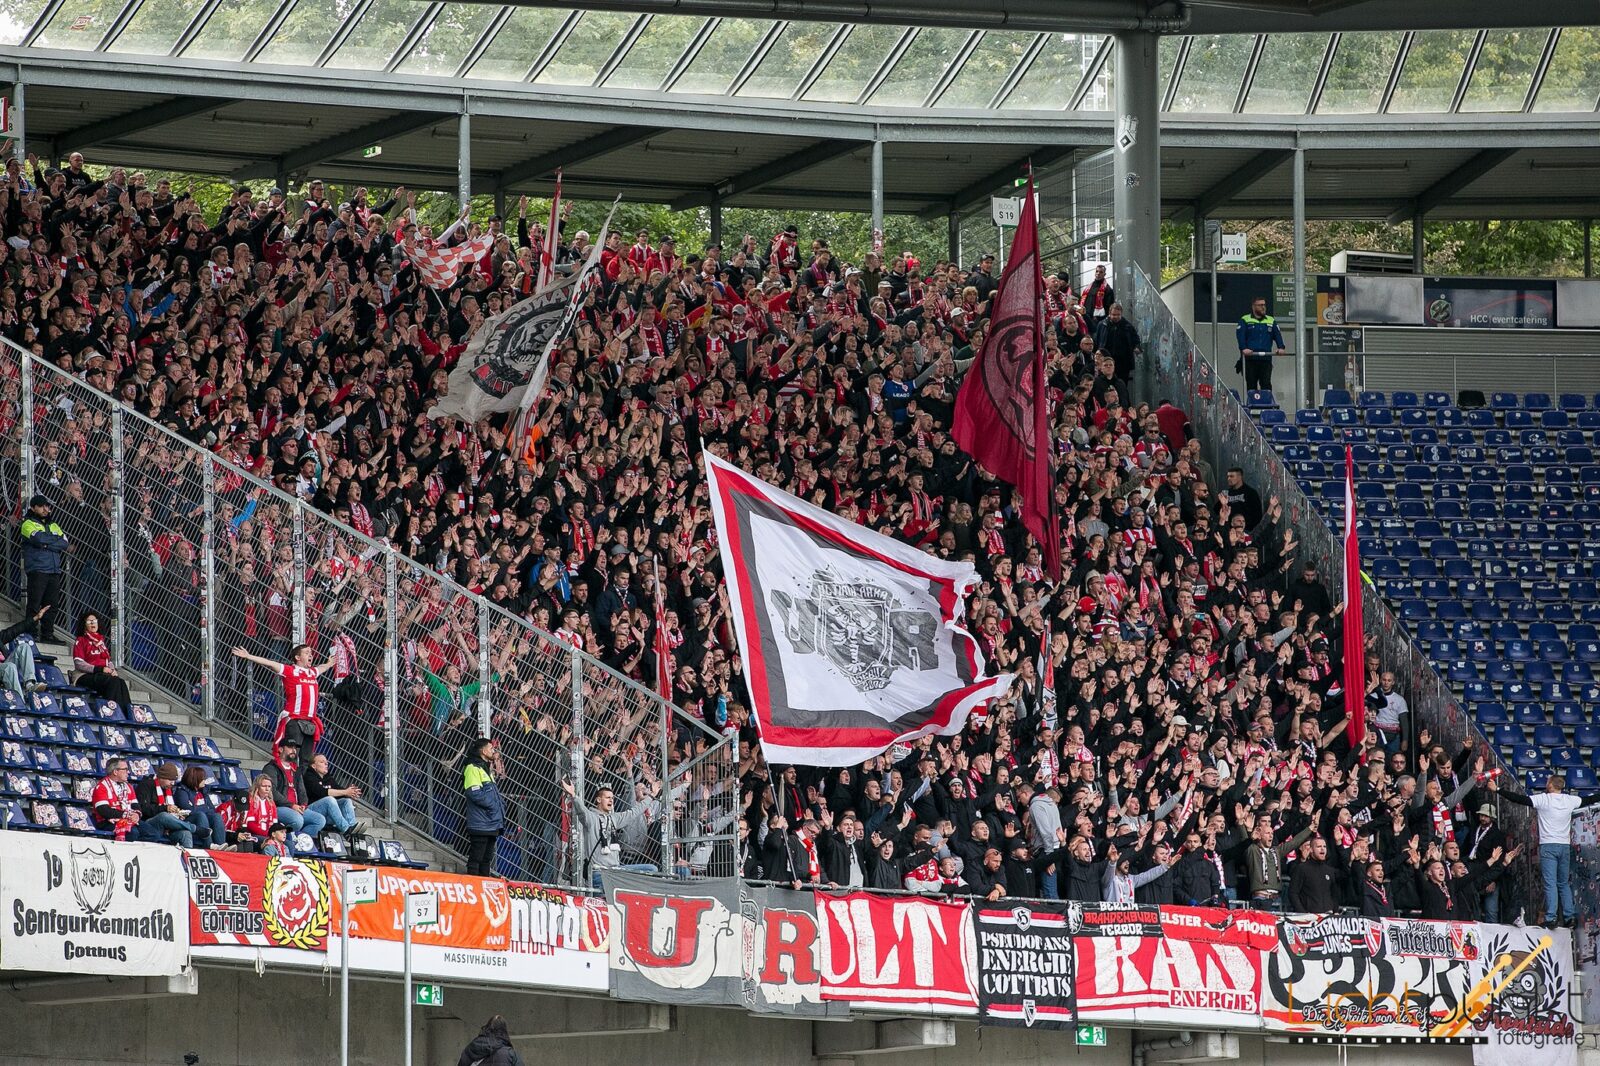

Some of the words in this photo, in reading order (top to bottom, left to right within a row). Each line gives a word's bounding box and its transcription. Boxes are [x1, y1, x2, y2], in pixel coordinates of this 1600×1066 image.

[999, 211, 1004, 219] S
[1006, 212, 1014, 220] 19
[1470, 314, 1488, 323] HCC
[1492, 315, 1548, 326] eventcatering
[43, 849, 63, 892] 19
[124, 855, 141, 898] 97
[189, 856, 219, 878] RED
[196, 883, 249, 907] EAGLES
[355, 886, 361, 895] S
[363, 885, 368, 894] 6
[417, 908, 422, 917] S
[424, 907, 429, 916] 7
[1084, 911, 1158, 924] BRANDENBURG
[1099, 901, 1138, 912] BERLIN
[13, 898, 174, 942] Senfgurkenmafia
[201, 910, 264, 934] COTTBUS
[511, 895, 580, 951] nord
[1100, 923, 1143, 937] TERROR
[1161, 911, 1201, 928] ELSTER
[1236, 919, 1276, 938] FRONT
[64, 940, 127, 962] Cottbus
[980, 931, 1071, 951] PSEUDOFANS
[1321, 935, 1353, 955] JUNGS
[444, 952, 508, 968] MASSIVHÄUSER
[982, 948, 1072, 975] ENERGIE
[982, 973, 1072, 998] COTTBUS
[1170, 989, 1253, 1011] ENERGIE
[1302, 1004, 1325, 1022] Die
[1376, 1014, 1393, 1023] von
